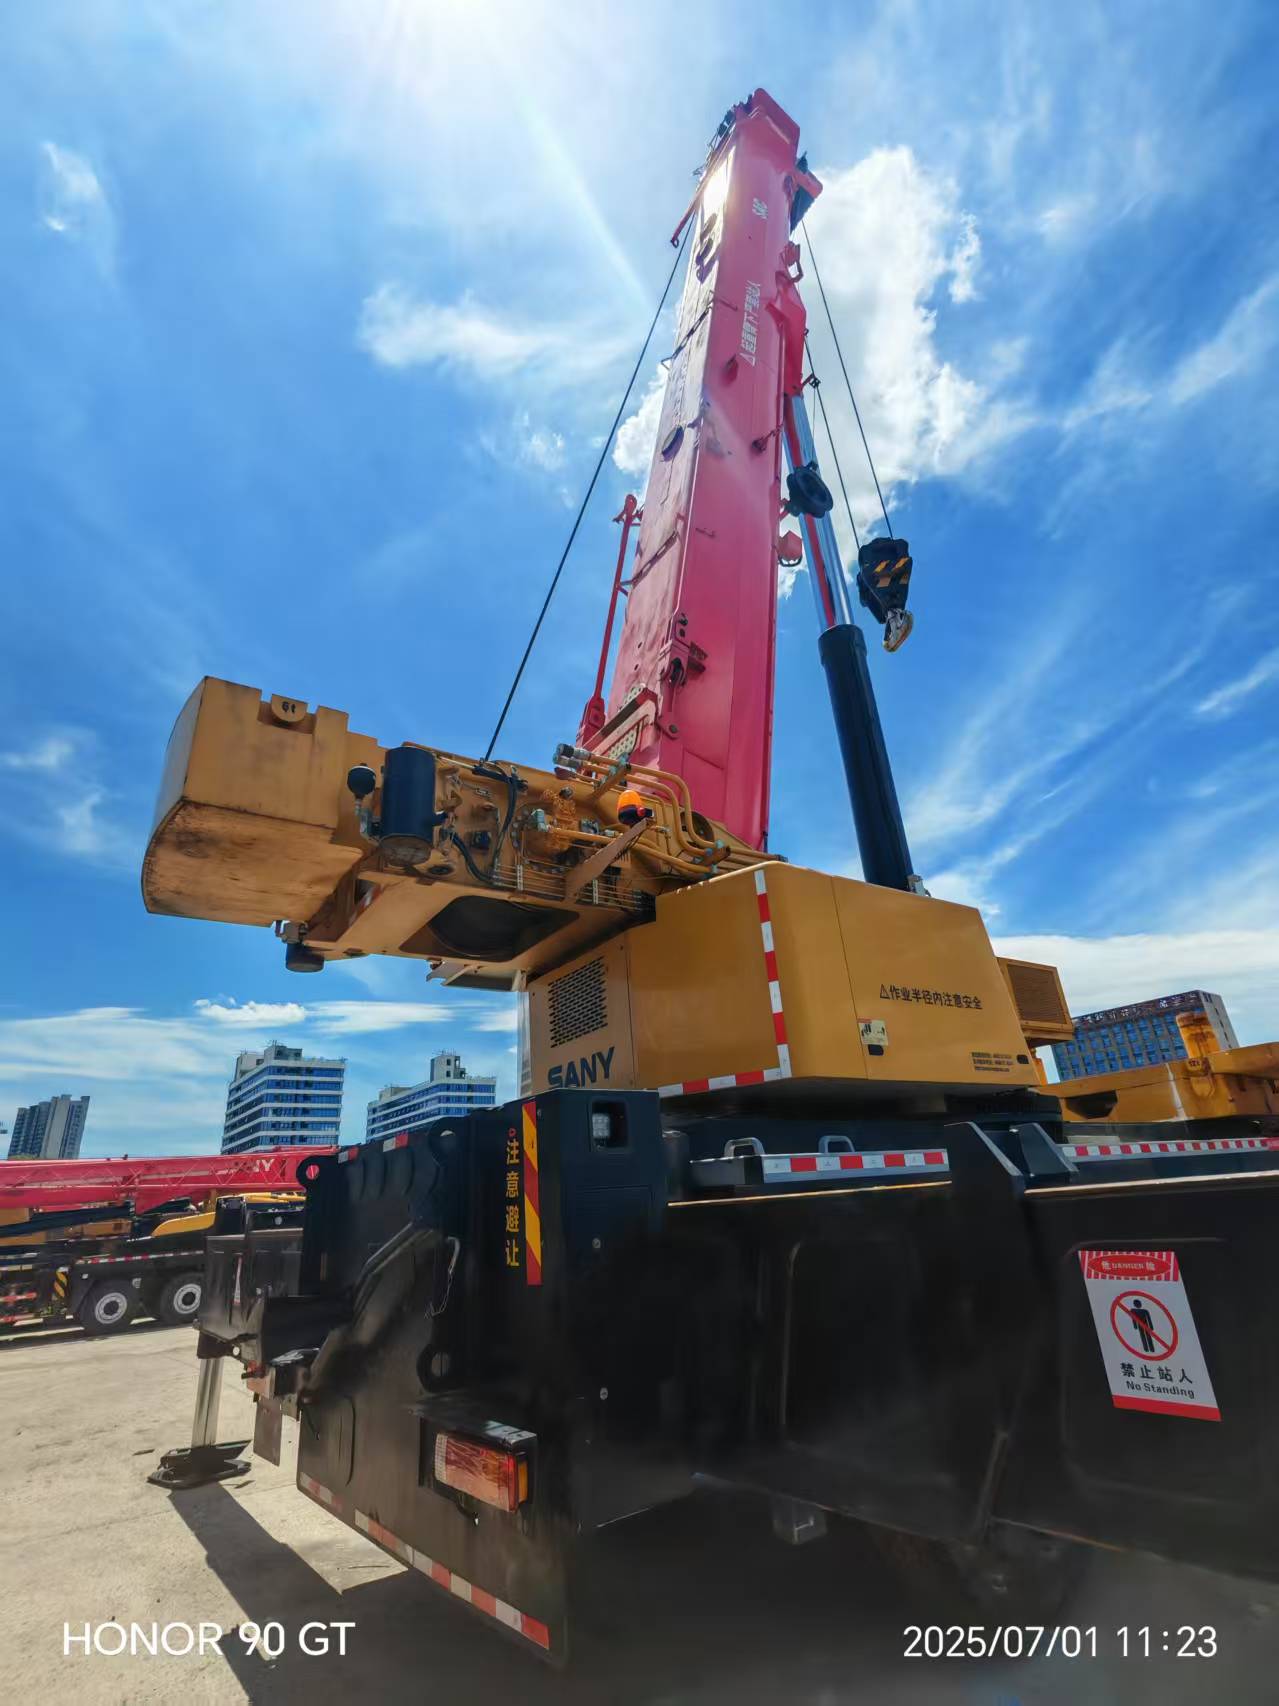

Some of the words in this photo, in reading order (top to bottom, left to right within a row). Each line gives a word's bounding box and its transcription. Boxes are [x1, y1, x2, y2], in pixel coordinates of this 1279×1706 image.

[889, 984, 983, 1010] 作业半径内注意安全
[548, 1046, 615, 1089] SANY
[506, 1138, 520, 1267] 注意避让
[1120, 1362, 1193, 1384] 禁止站人
[1126, 1380, 1141, 1391] No
[1144, 1382, 1195, 1399] Standing
